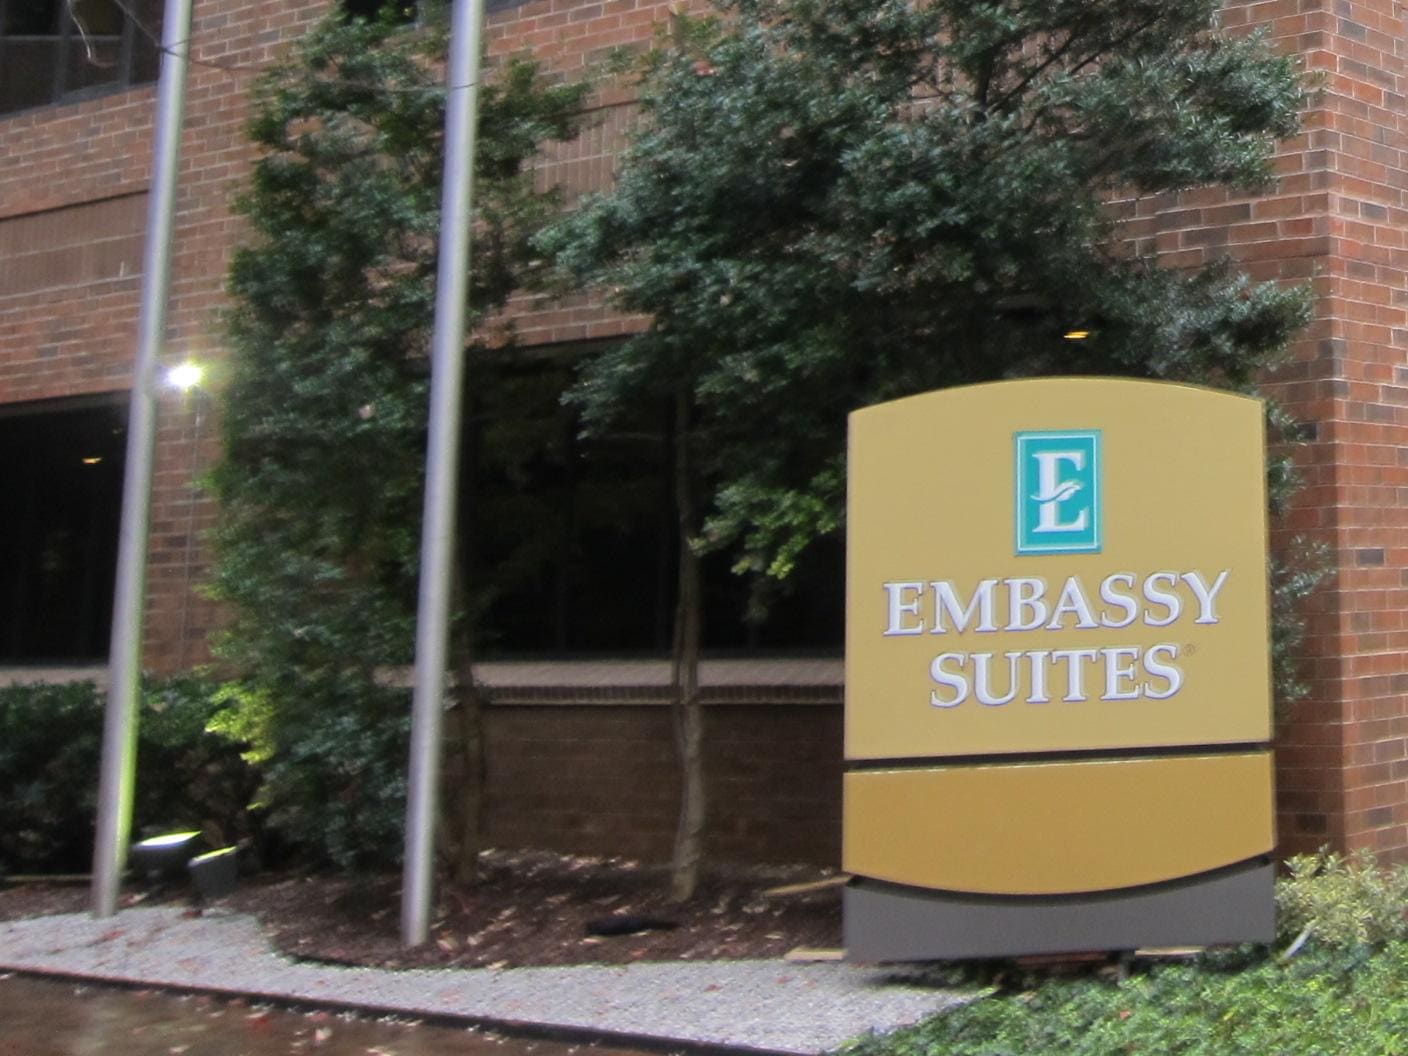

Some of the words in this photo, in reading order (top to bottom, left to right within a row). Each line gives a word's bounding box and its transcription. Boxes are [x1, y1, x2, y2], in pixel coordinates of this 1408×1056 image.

[1031, 450, 1088, 533] E
[882, 569, 1230, 636] EMBASSY
[929, 643, 1184, 709] SUITES
